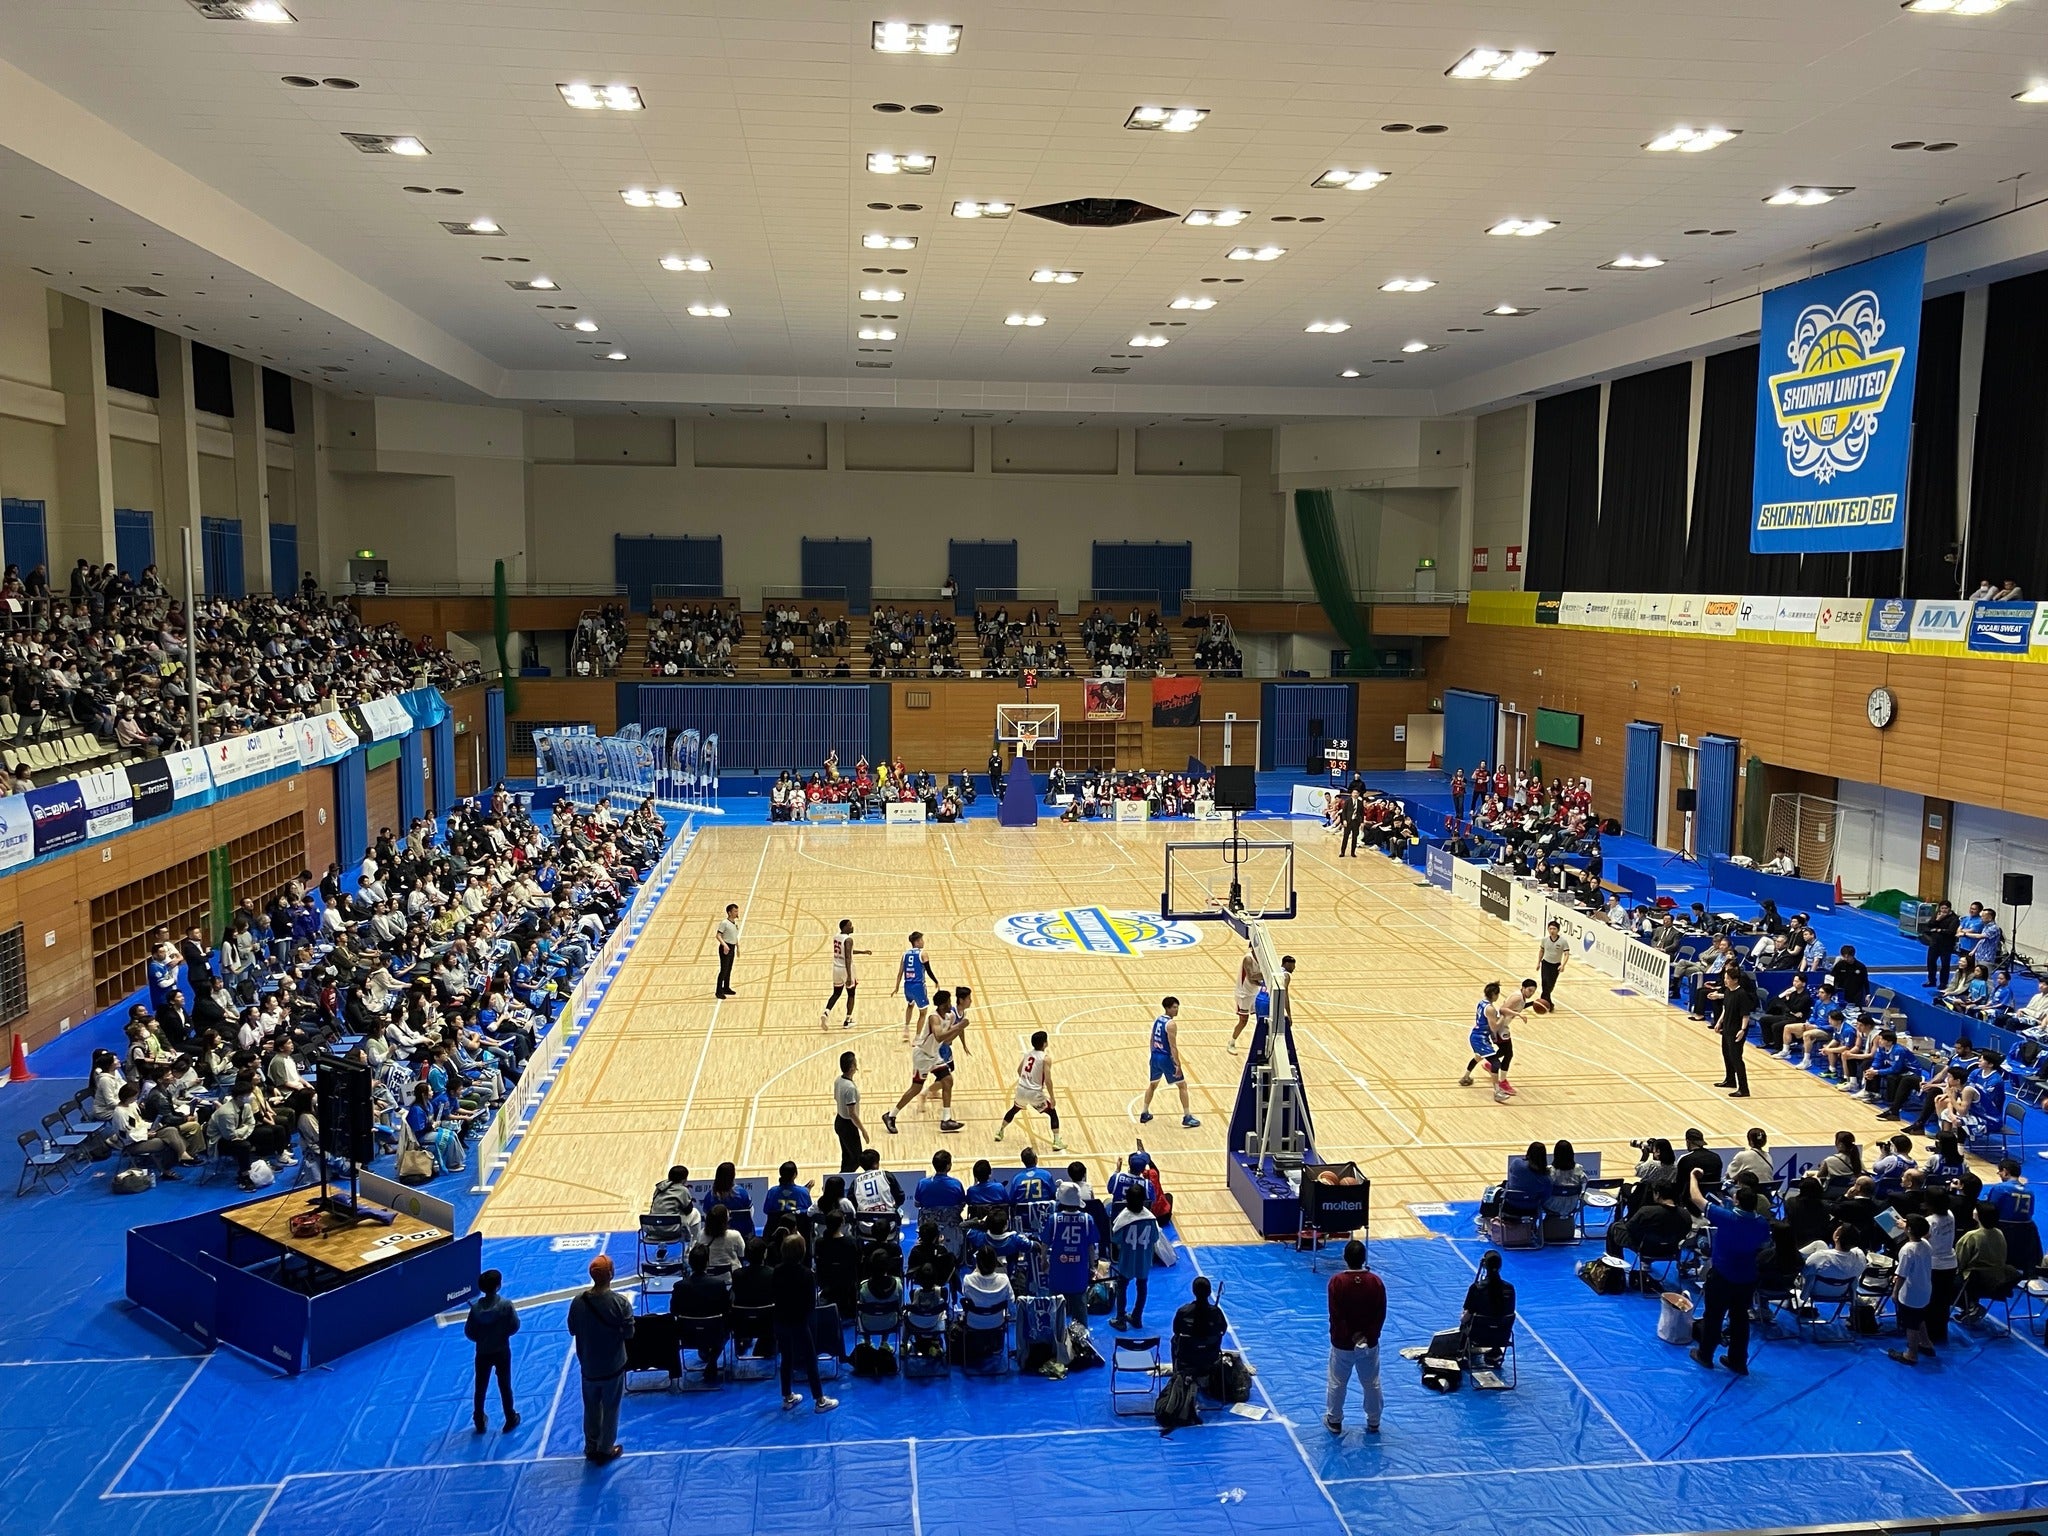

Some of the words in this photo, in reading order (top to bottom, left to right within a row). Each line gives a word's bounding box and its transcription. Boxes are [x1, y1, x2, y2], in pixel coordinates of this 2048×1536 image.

[1782, 380, 1833, 411] SHONAN
[1834, 370, 1886, 403] UNITED
[1820, 415, 1837, 436] BC
[1761, 503, 1814, 528] SHONAN
[1814, 499, 1868, 526] UNITED
[1869, 495, 1895, 522] BC
[1835, 611, 1863, 623] 日本生命
[1977, 624, 1999, 632] POCARI
[2000, 625, 2023, 633] SWEAT
[1332, 739, 1348, 749] 9:39
[1339, 760, 1347, 770] 55
[1487, 886, 1509, 908] SoftBank
[908, 955, 915, 967] 9
[1025, 1056, 1036, 1074] 3
[864, 1179, 879, 1198] 91
[1021, 1178, 1042, 1199] 73
[1322, 1201, 1363, 1211] molten
[2011, 1192, 2032, 1214] 73
[1061, 1225, 1082, 1245] 45
[1125, 1224, 1152, 1250] 44
